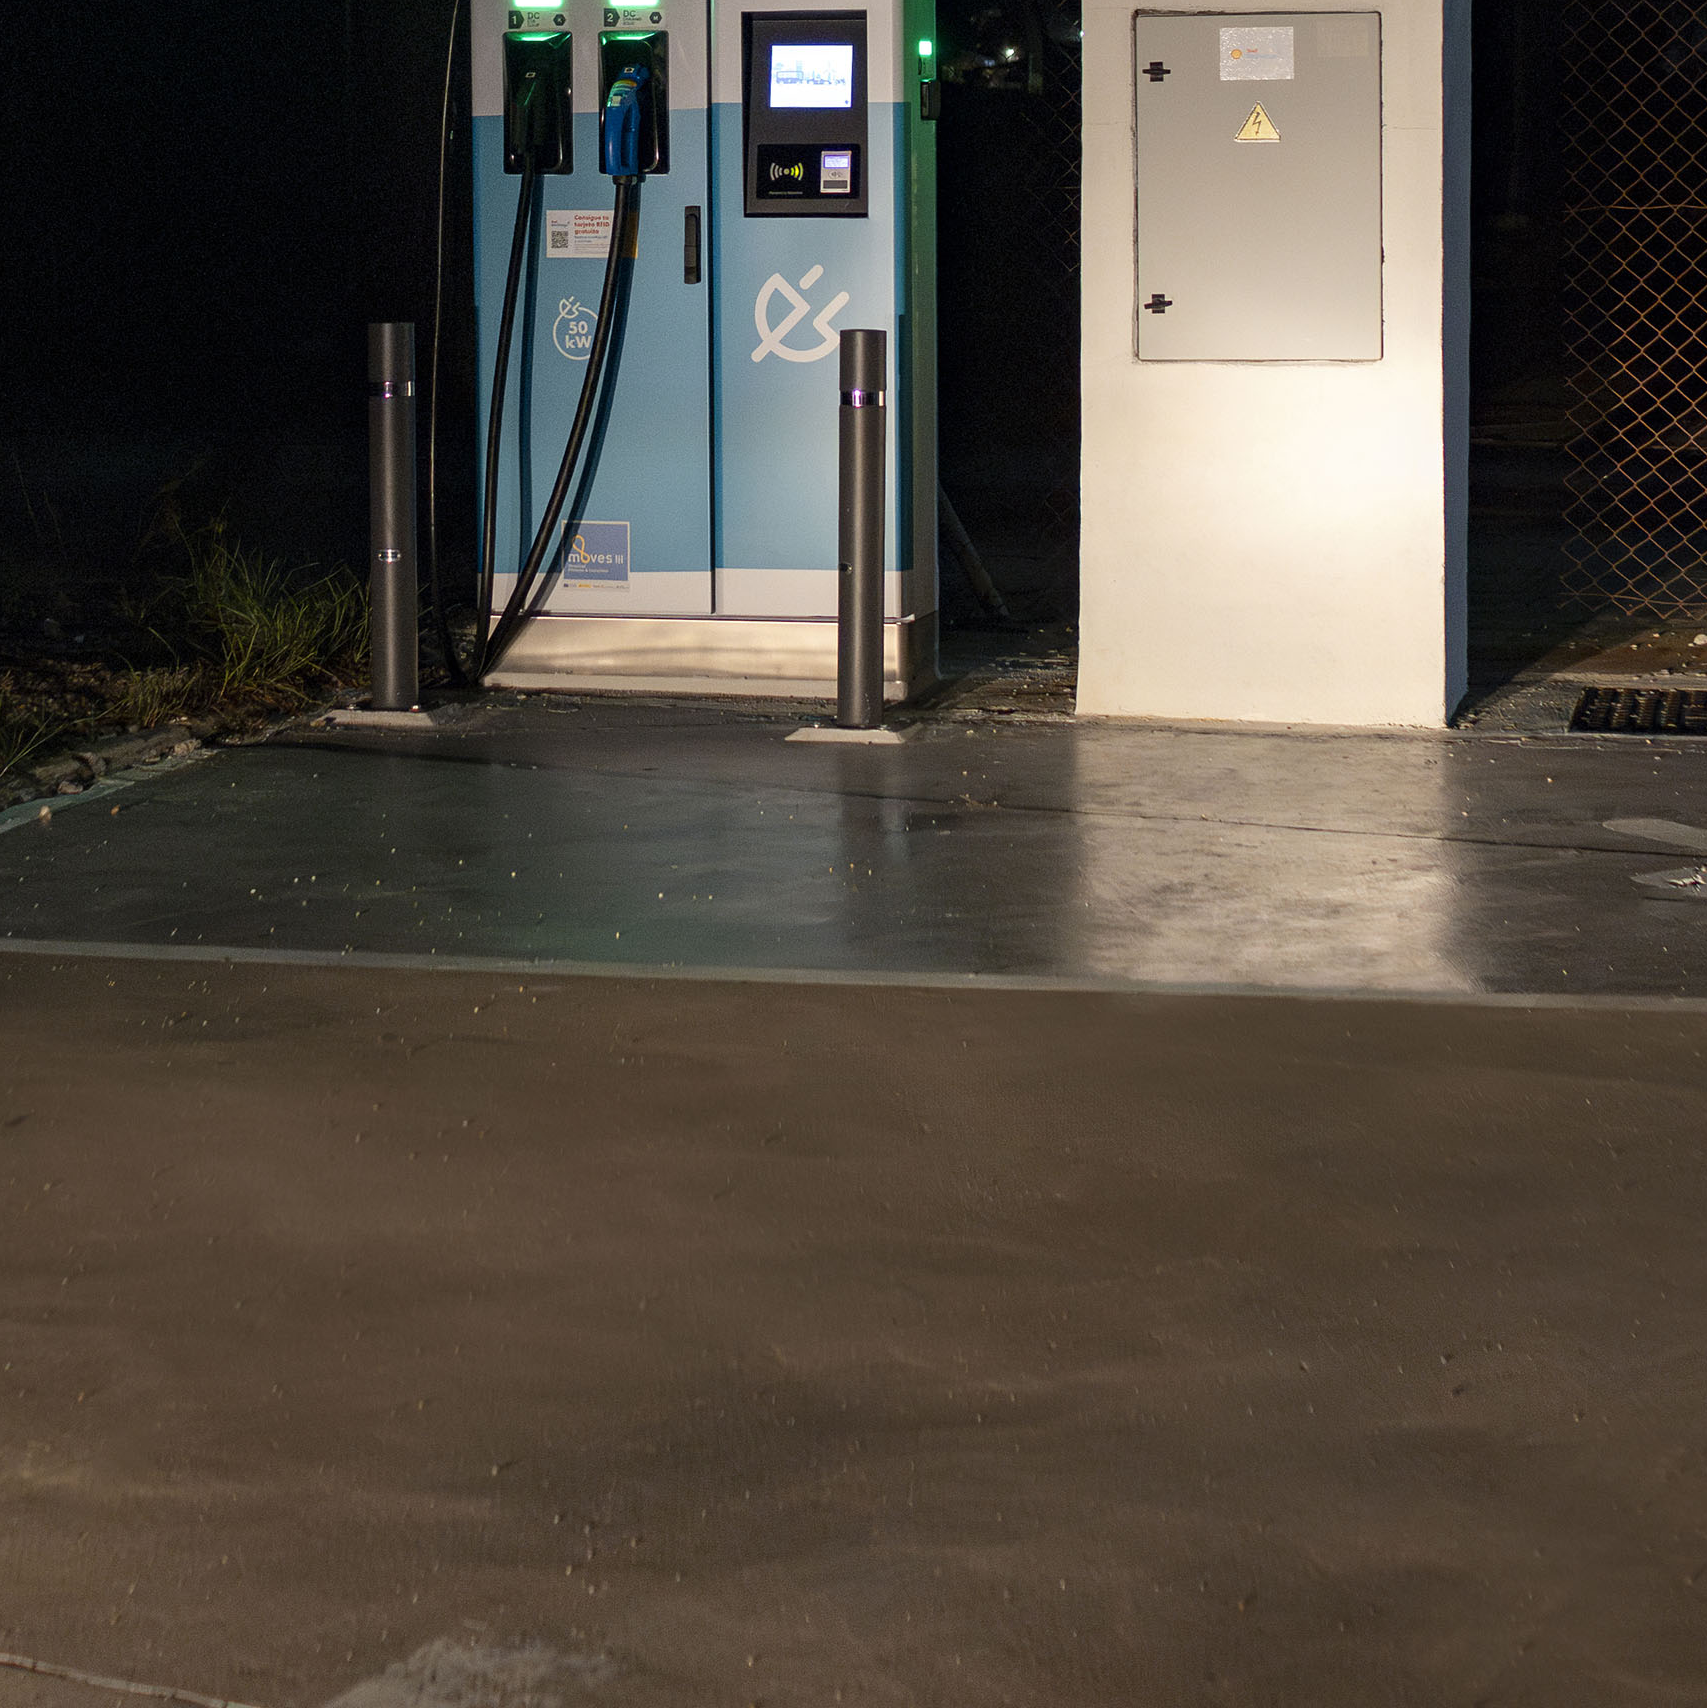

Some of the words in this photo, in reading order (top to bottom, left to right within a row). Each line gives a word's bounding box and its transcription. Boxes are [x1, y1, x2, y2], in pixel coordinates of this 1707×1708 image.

[527, 12, 540, 20] DC
[607, 13, 614, 23] 2
[623, 10, 637, 18] DC
[568, 321, 589, 334] 50
[565, 335, 592, 349] kW
